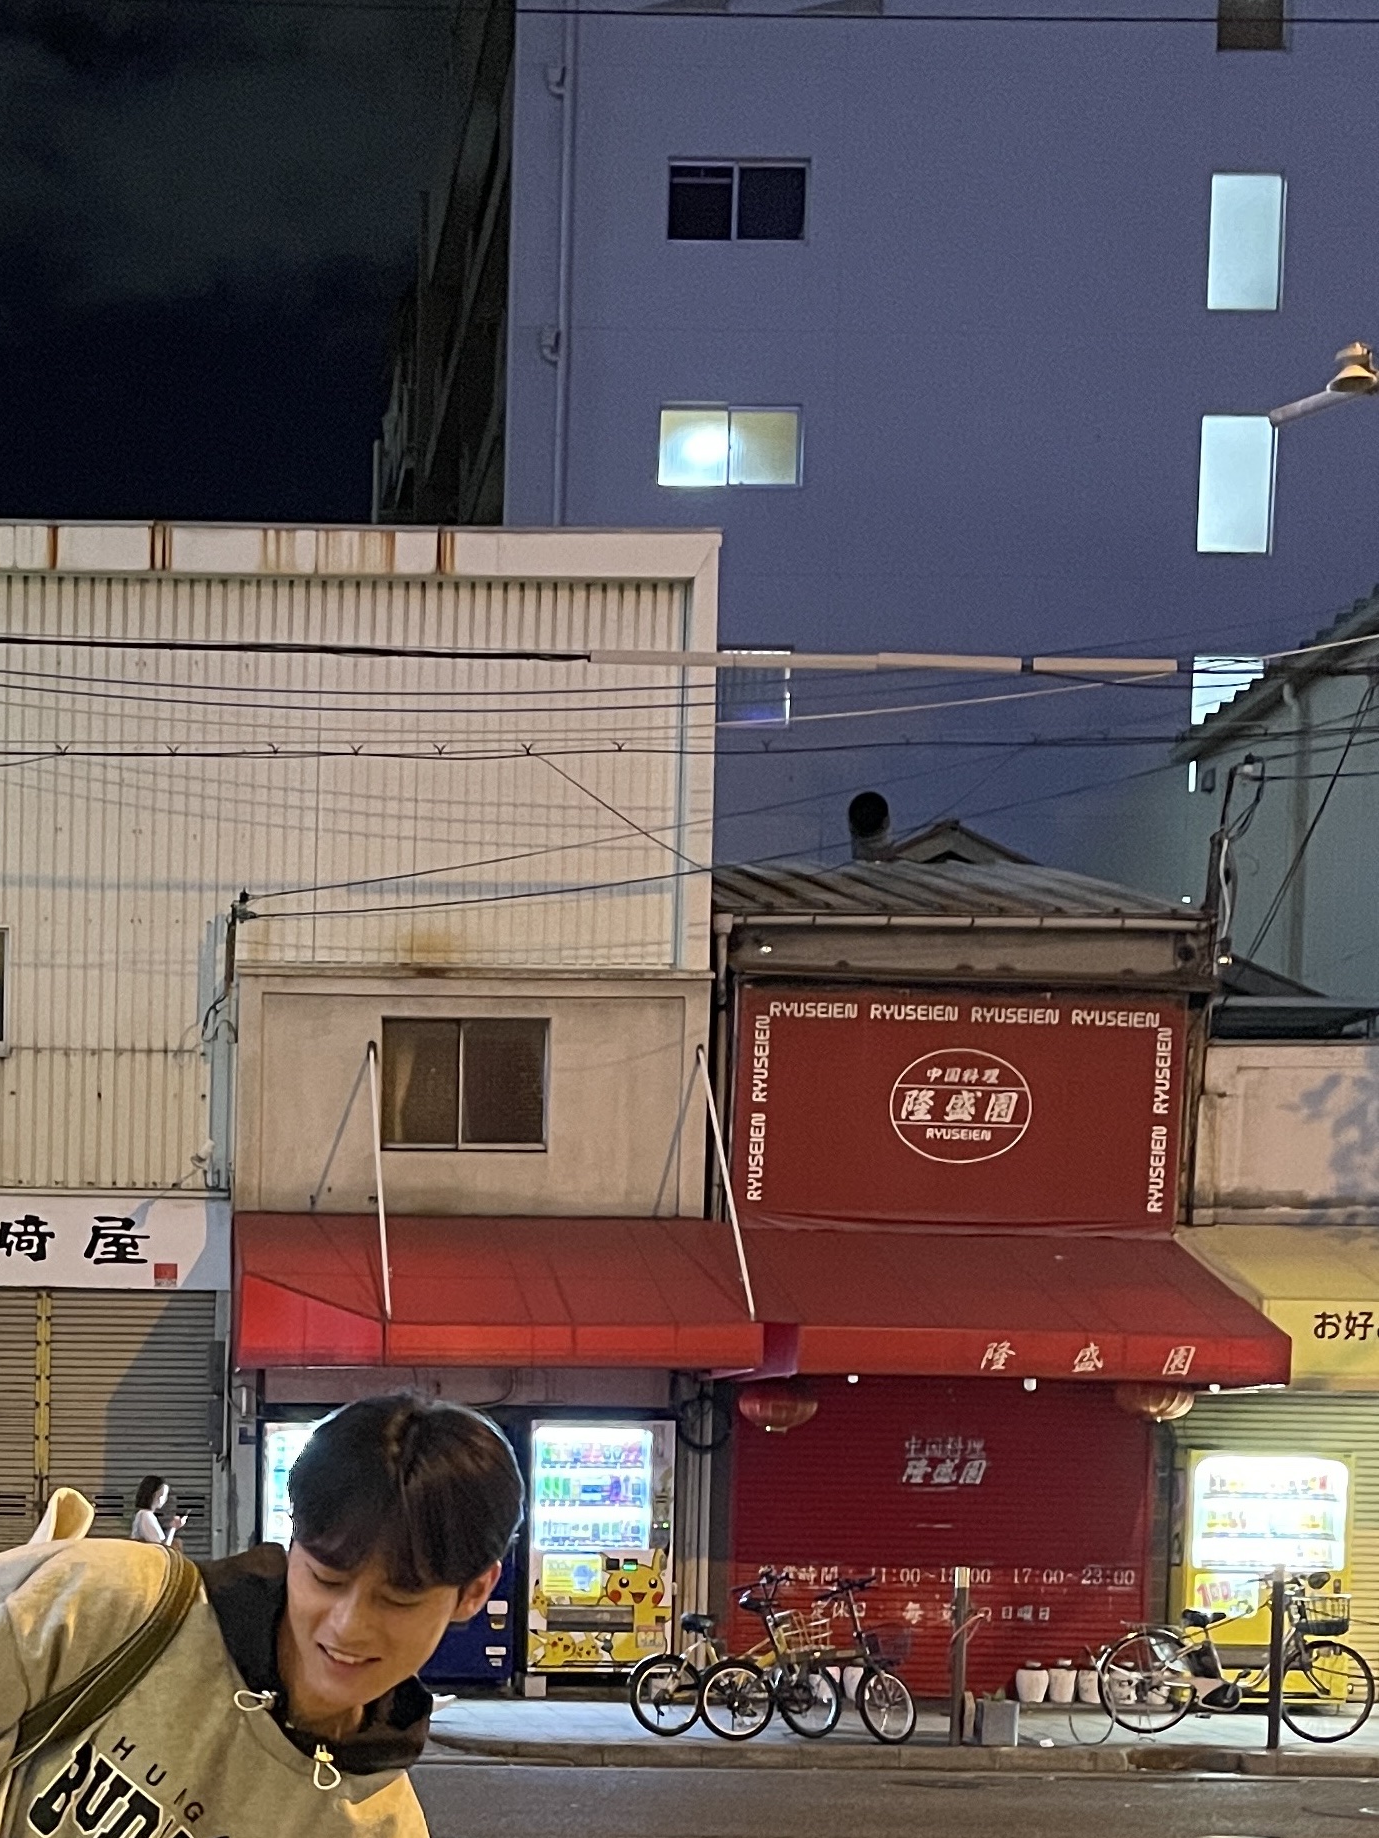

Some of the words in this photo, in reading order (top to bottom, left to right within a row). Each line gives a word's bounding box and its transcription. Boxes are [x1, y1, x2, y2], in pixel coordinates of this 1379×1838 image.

[769, 1001, 858, 1019] RYUSEIEN
[870, 1003, 959, 1022] RYUSEIEN
[971, 1006, 1060, 1025] RYUSEIEN
[1071, 1009, 1160, 1028] RYUSEIEN
[751, 1015, 770, 1102] RYUSEIEN
[926, 1067, 1000, 1084] 中国料理
[1153, 1027, 1172, 1114] RYUSEIEN
[900, 1089, 1019, 1123] 隆盛園
[925, 1128, 992, 1141] RYUSEIEN
[746, 1112, 766, 1202] RYUSEIEN
[1147, 1125, 1167, 1213] RYUSEIEN
[1313, 1310, 1379, 1341] お好
[980, 1340, 1197, 1376] 隆盛園
